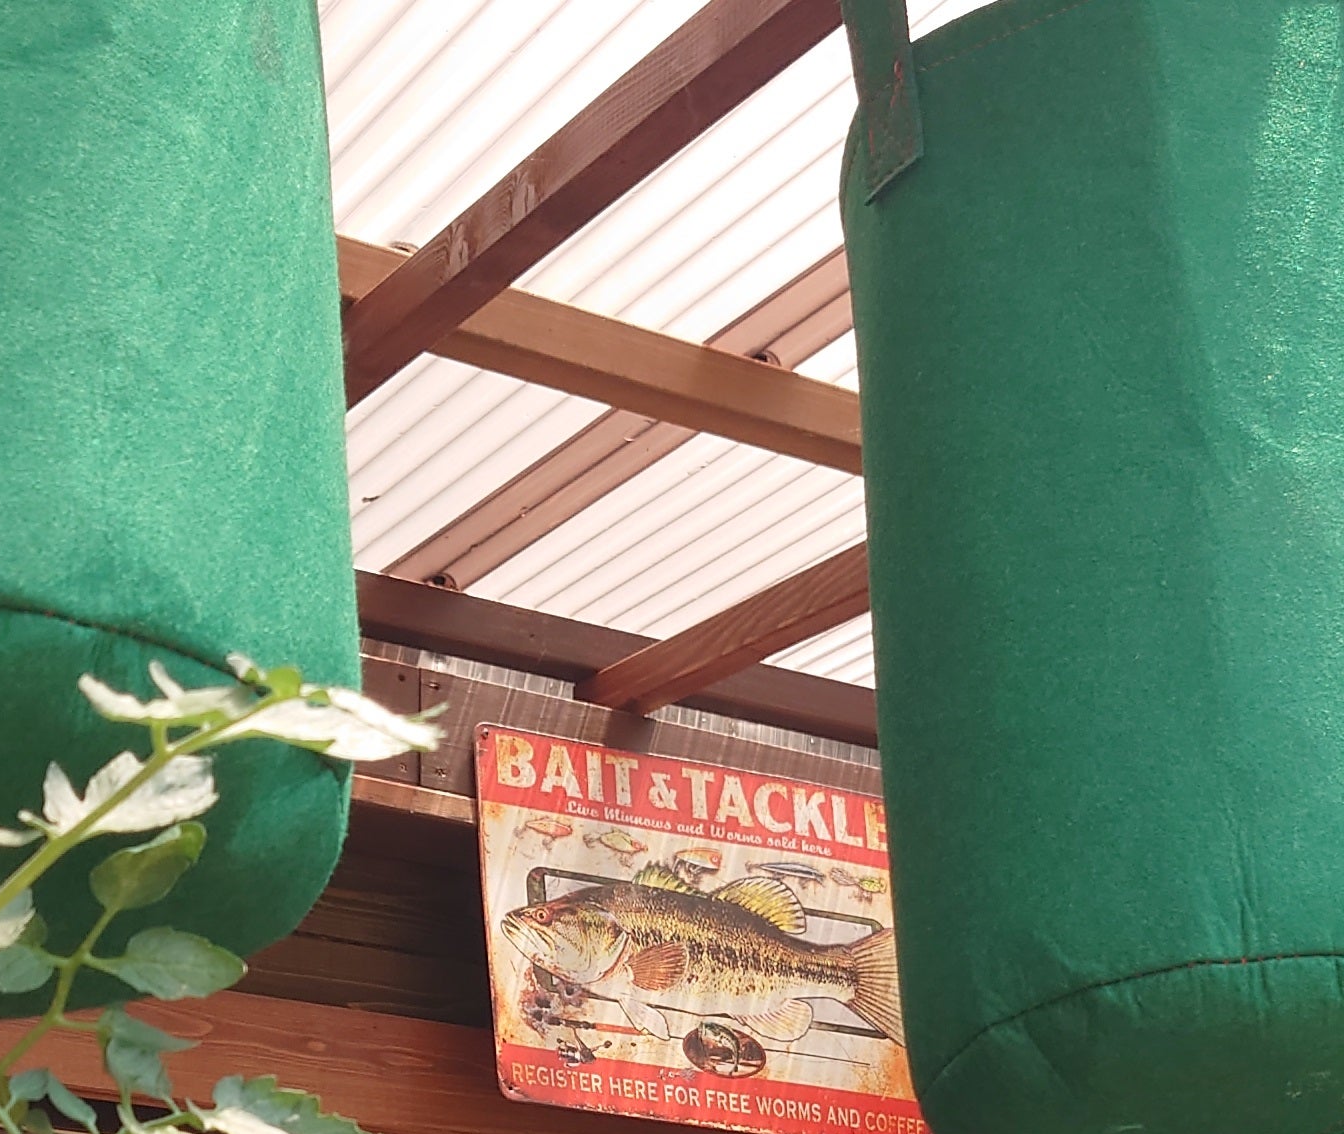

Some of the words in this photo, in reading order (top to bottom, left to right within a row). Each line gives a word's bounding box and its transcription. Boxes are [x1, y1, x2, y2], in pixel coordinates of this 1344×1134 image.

[495, 734, 639, 808] BAIT
[648, 772, 679, 811] &
[681, 767, 888, 852] TACKLE
[566, 800, 599, 818] Live
[604, 806, 672, 830] Minnows
[677, 822, 704, 836] and
[710, 824, 762, 845] Worms
[767, 835, 797, 850] sold
[801, 839, 833, 857] here
[511, 1062, 603, 1094] REGISTER
[609, 1076, 659, 1101] HERE
[664, 1084, 701, 1107] FOR
[705, 1089, 752, 1114] FREE
[755, 1096, 822, 1123] WORMS
[826, 1105, 861, 1129] AND
